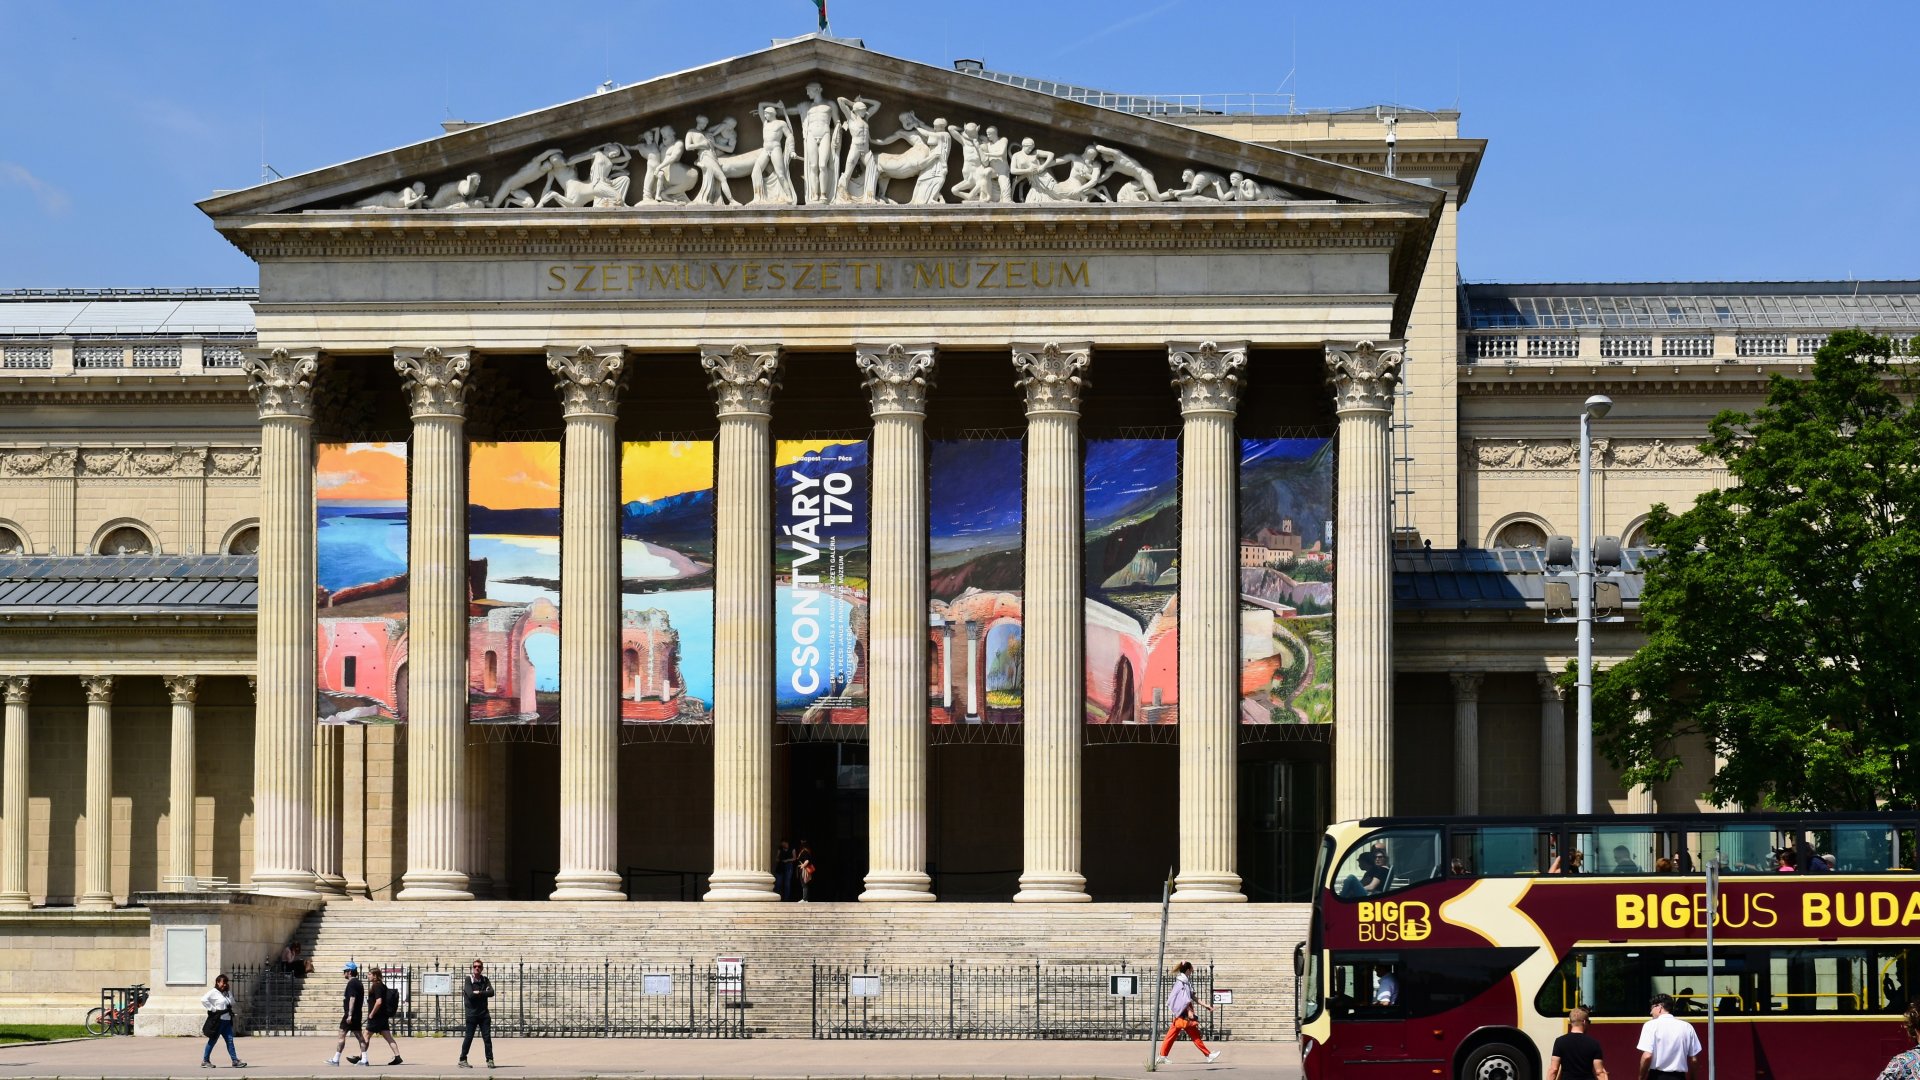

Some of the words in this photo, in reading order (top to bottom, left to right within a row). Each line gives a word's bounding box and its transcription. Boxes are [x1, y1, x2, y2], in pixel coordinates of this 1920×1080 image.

[823, 472, 853, 527] 170
[782, 470, 820, 695] CSONTVÁRY
[837, 675, 844, 684] ÉS
[1358, 901, 1399, 922] BIG
[1358, 923, 1399, 942] BUS
